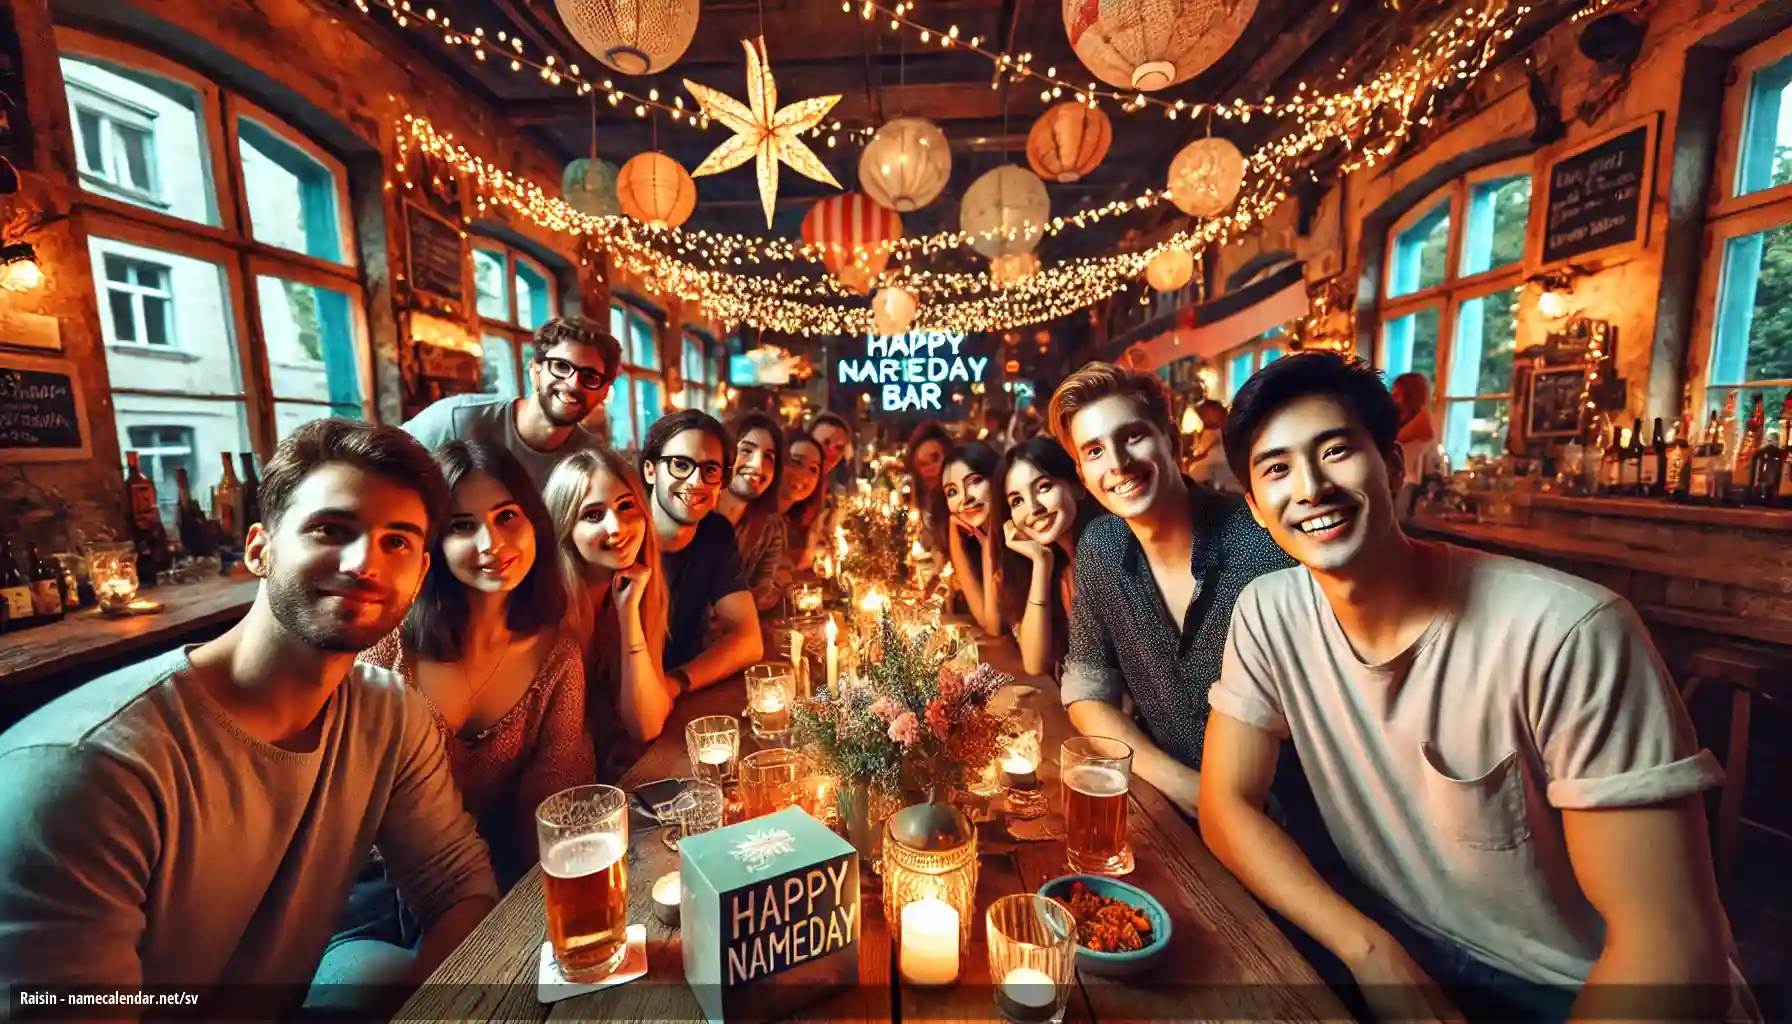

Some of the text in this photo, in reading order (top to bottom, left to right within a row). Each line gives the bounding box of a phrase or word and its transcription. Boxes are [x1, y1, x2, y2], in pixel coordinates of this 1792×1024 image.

[868, 331, 965, 357] HAPPY
[882, 383, 942, 412] BAR
[732, 860, 849, 940] HAPPY
[727, 903, 857, 986] NAMEDAY
